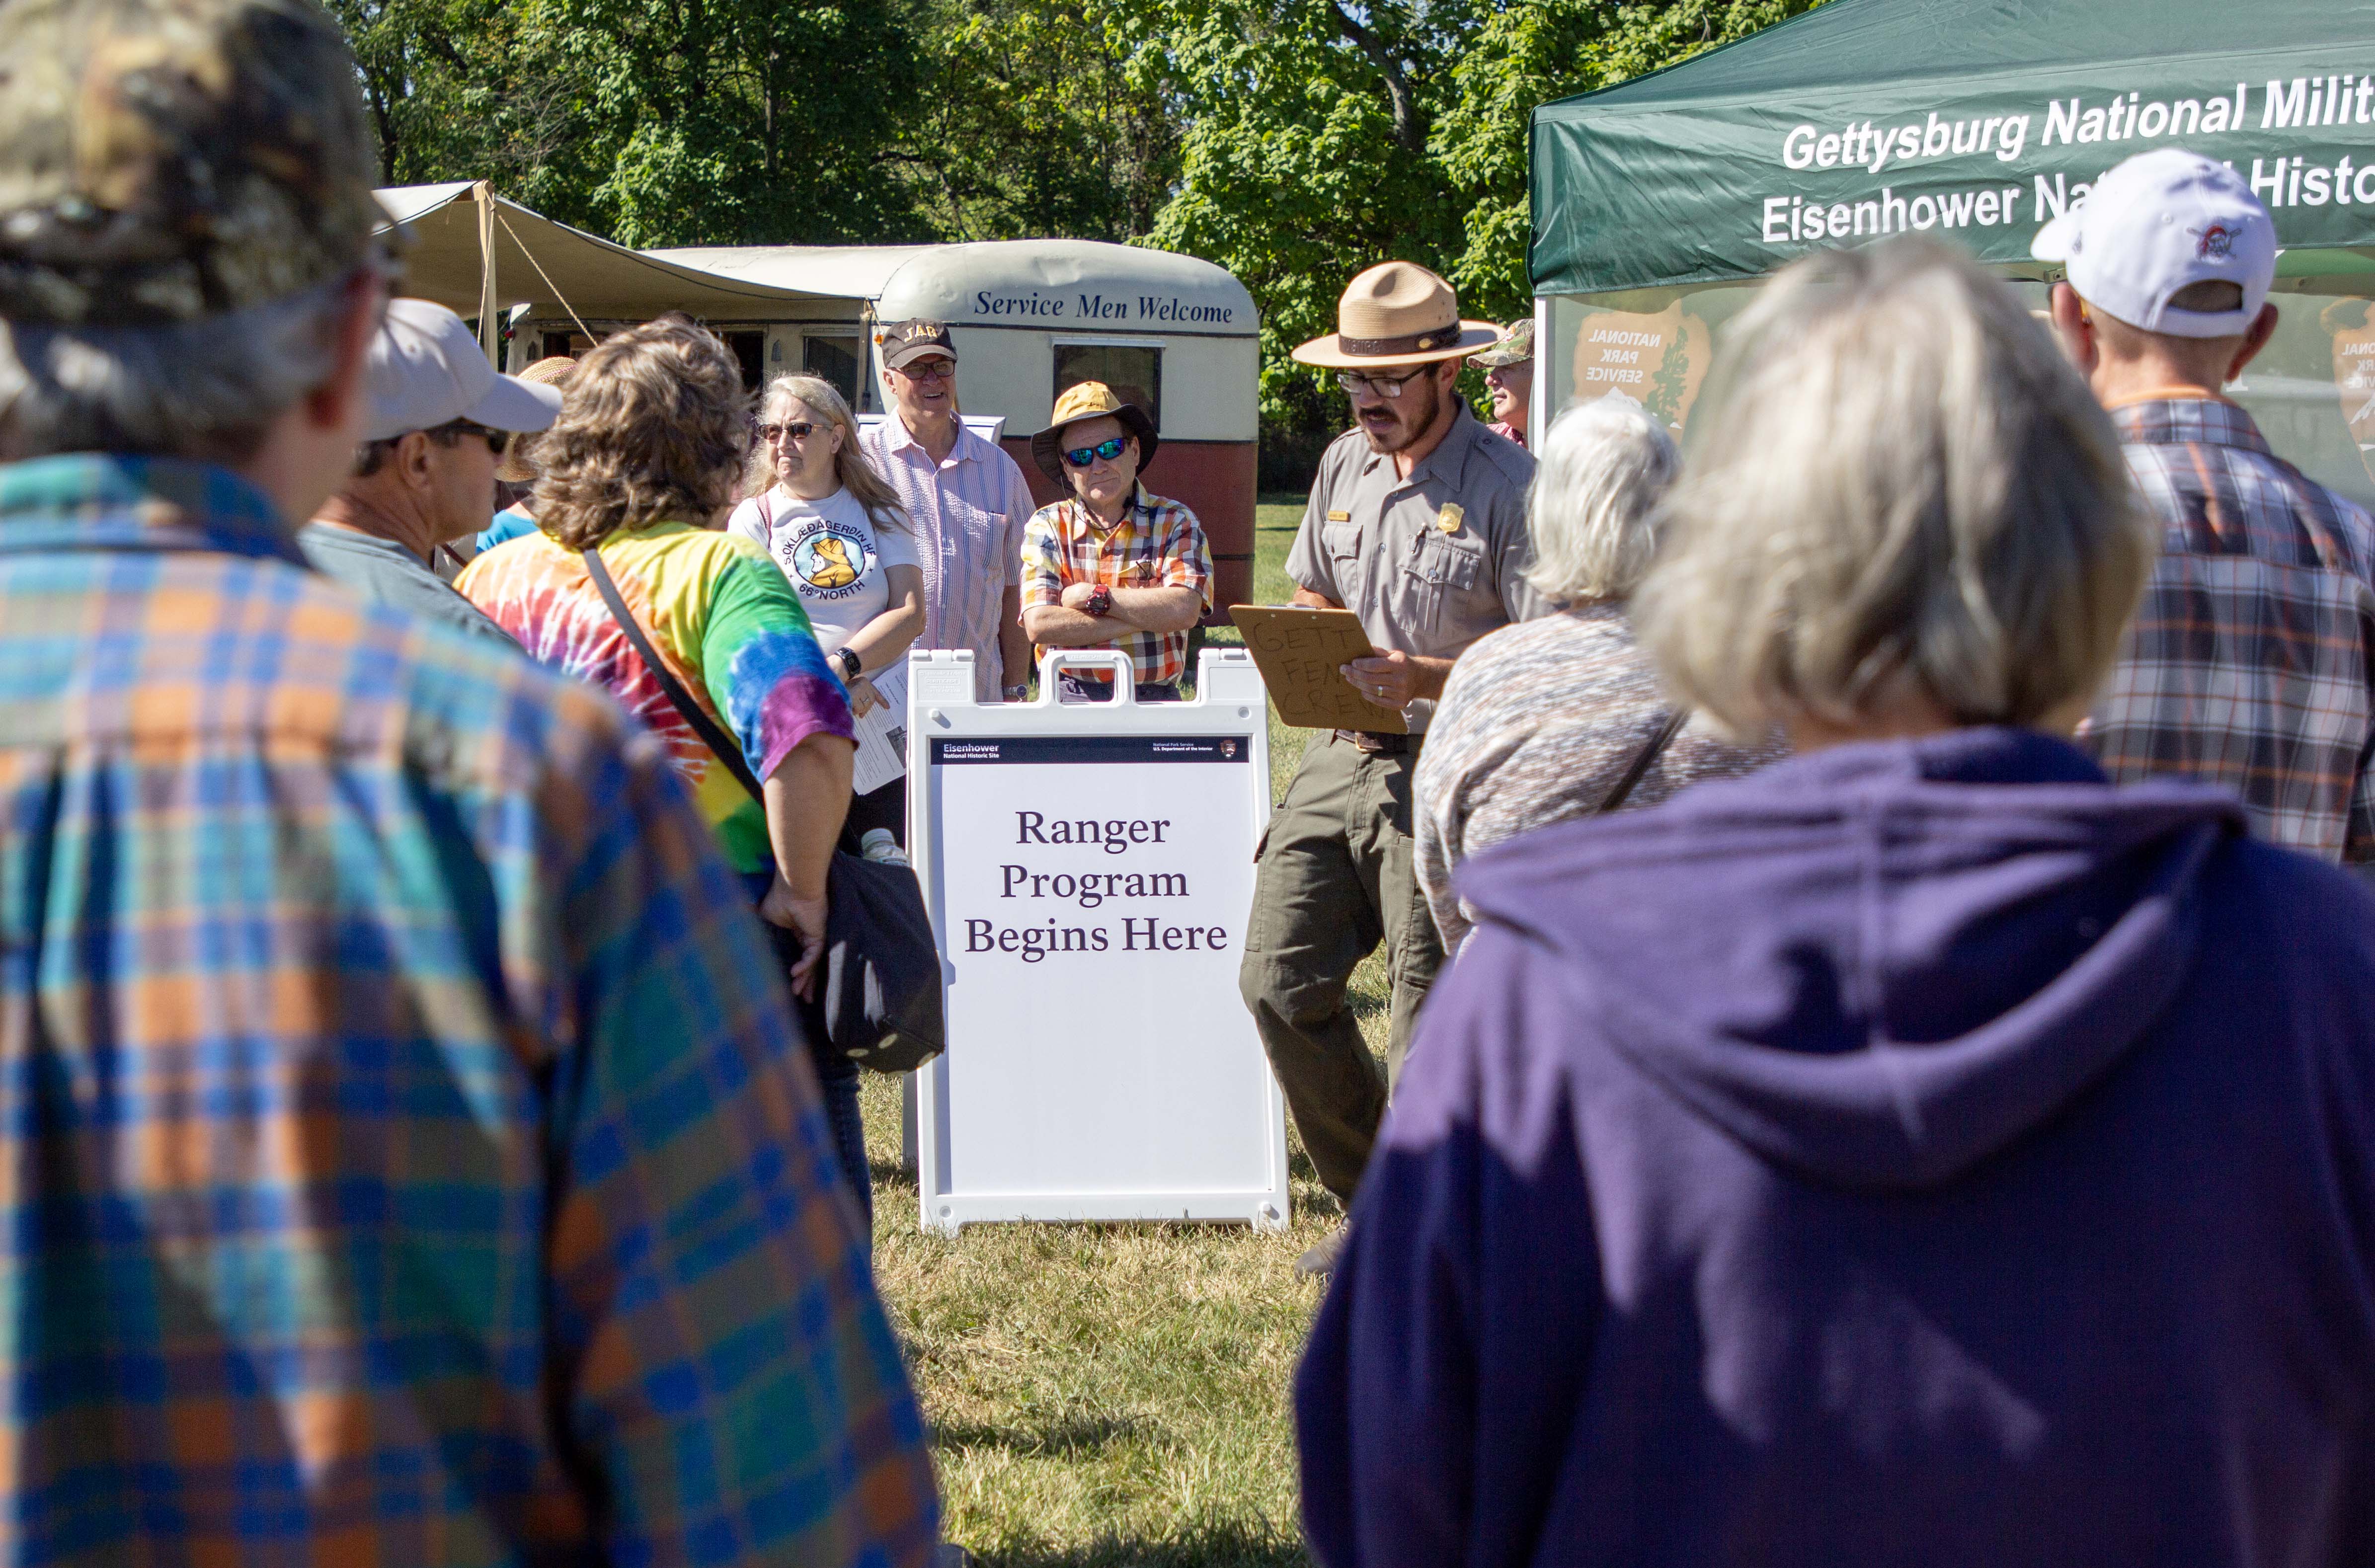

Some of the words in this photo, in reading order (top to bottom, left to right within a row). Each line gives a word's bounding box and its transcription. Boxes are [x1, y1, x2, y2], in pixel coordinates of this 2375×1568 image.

[1783, 112, 2030, 173] Gettysburg
[2041, 82, 2246, 146] National
[2260, 75, 2375, 129] Milit
[1763, 188, 2020, 242] Eisenhower
[974, 291, 1064, 315] Service
[1076, 294, 1127, 319] Men
[1138, 296, 1233, 323] Welcome
[904, 324, 938, 342] JAG
[863, 543, 876, 556] HF
[799, 580, 865, 600] 66°NORTH
[1280, 658, 1340, 685] FEN
[944, 743, 999, 752] Eisenhower
[1015, 811, 1171, 855] Ranger
[1000, 864, 1190, 909] Program
[964, 918, 1108, 963] Begins
[1121, 917, 1228, 951] Here
